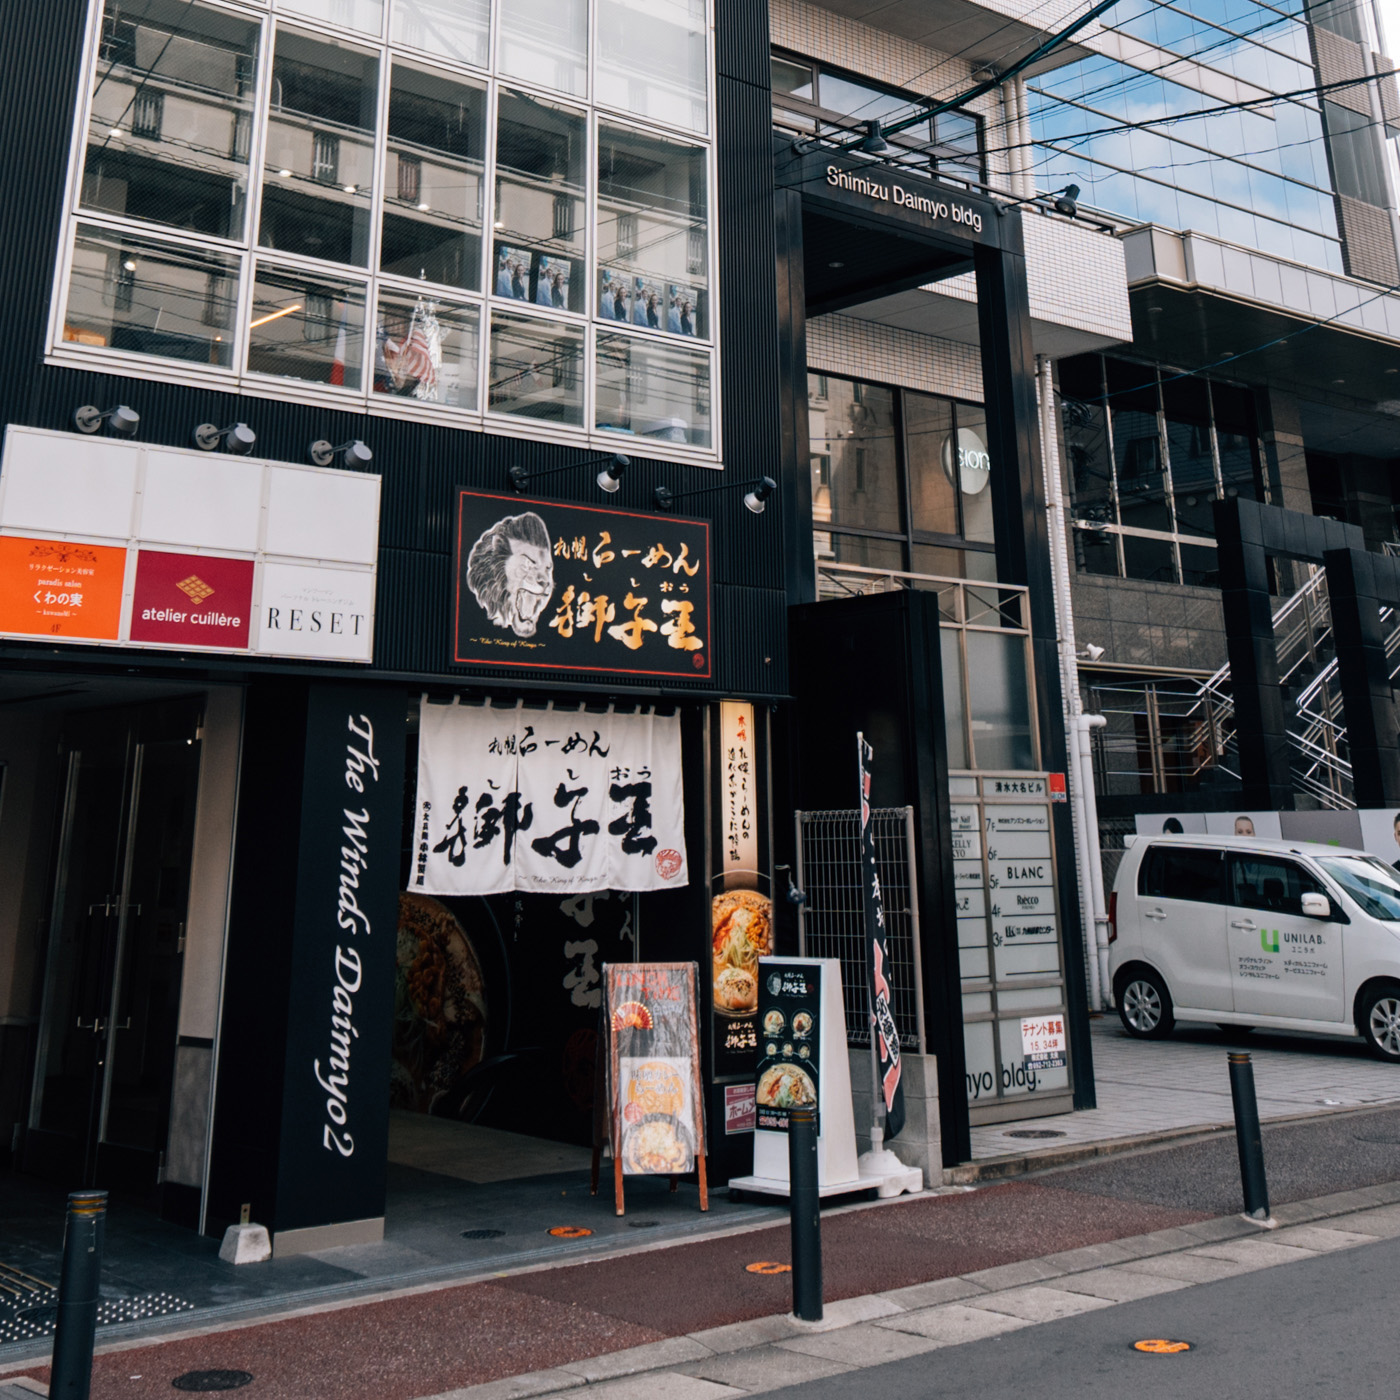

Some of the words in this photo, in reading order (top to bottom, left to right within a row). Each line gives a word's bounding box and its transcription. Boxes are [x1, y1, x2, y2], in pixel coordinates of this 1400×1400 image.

[826, 165, 889, 201] Shimizu
[893, 185, 948, 220] Daimyo
[952, 203, 983, 233] bldg
[553, 531, 699, 577] 札幌らーめん
[33, 590, 83, 607] くわの実
[141, 607, 188, 624] atelier
[190, 609, 241, 628] cuillère
[267, 607, 365, 635] RESET
[549, 585, 704, 651] 獅子王
[488, 726, 610, 758] 札幌らーめん
[345, 714, 379, 793] The
[995, 782, 1043, 793] 清水大名ビル
[433, 782, 658, 869] 獅子王
[986, 818, 996, 832] 7F
[987, 847, 998, 861] 6F
[337, 807, 371, 935] Winds
[1007, 866, 1044, 880] BLANC
[989, 875, 1000, 890] 5F
[991, 904, 1001, 918] 4F
[993, 932, 1004, 947] 3F
[1023, 1021, 1063, 1037] テナント募集
[314, 945, 363, 1157] Daimyo2
